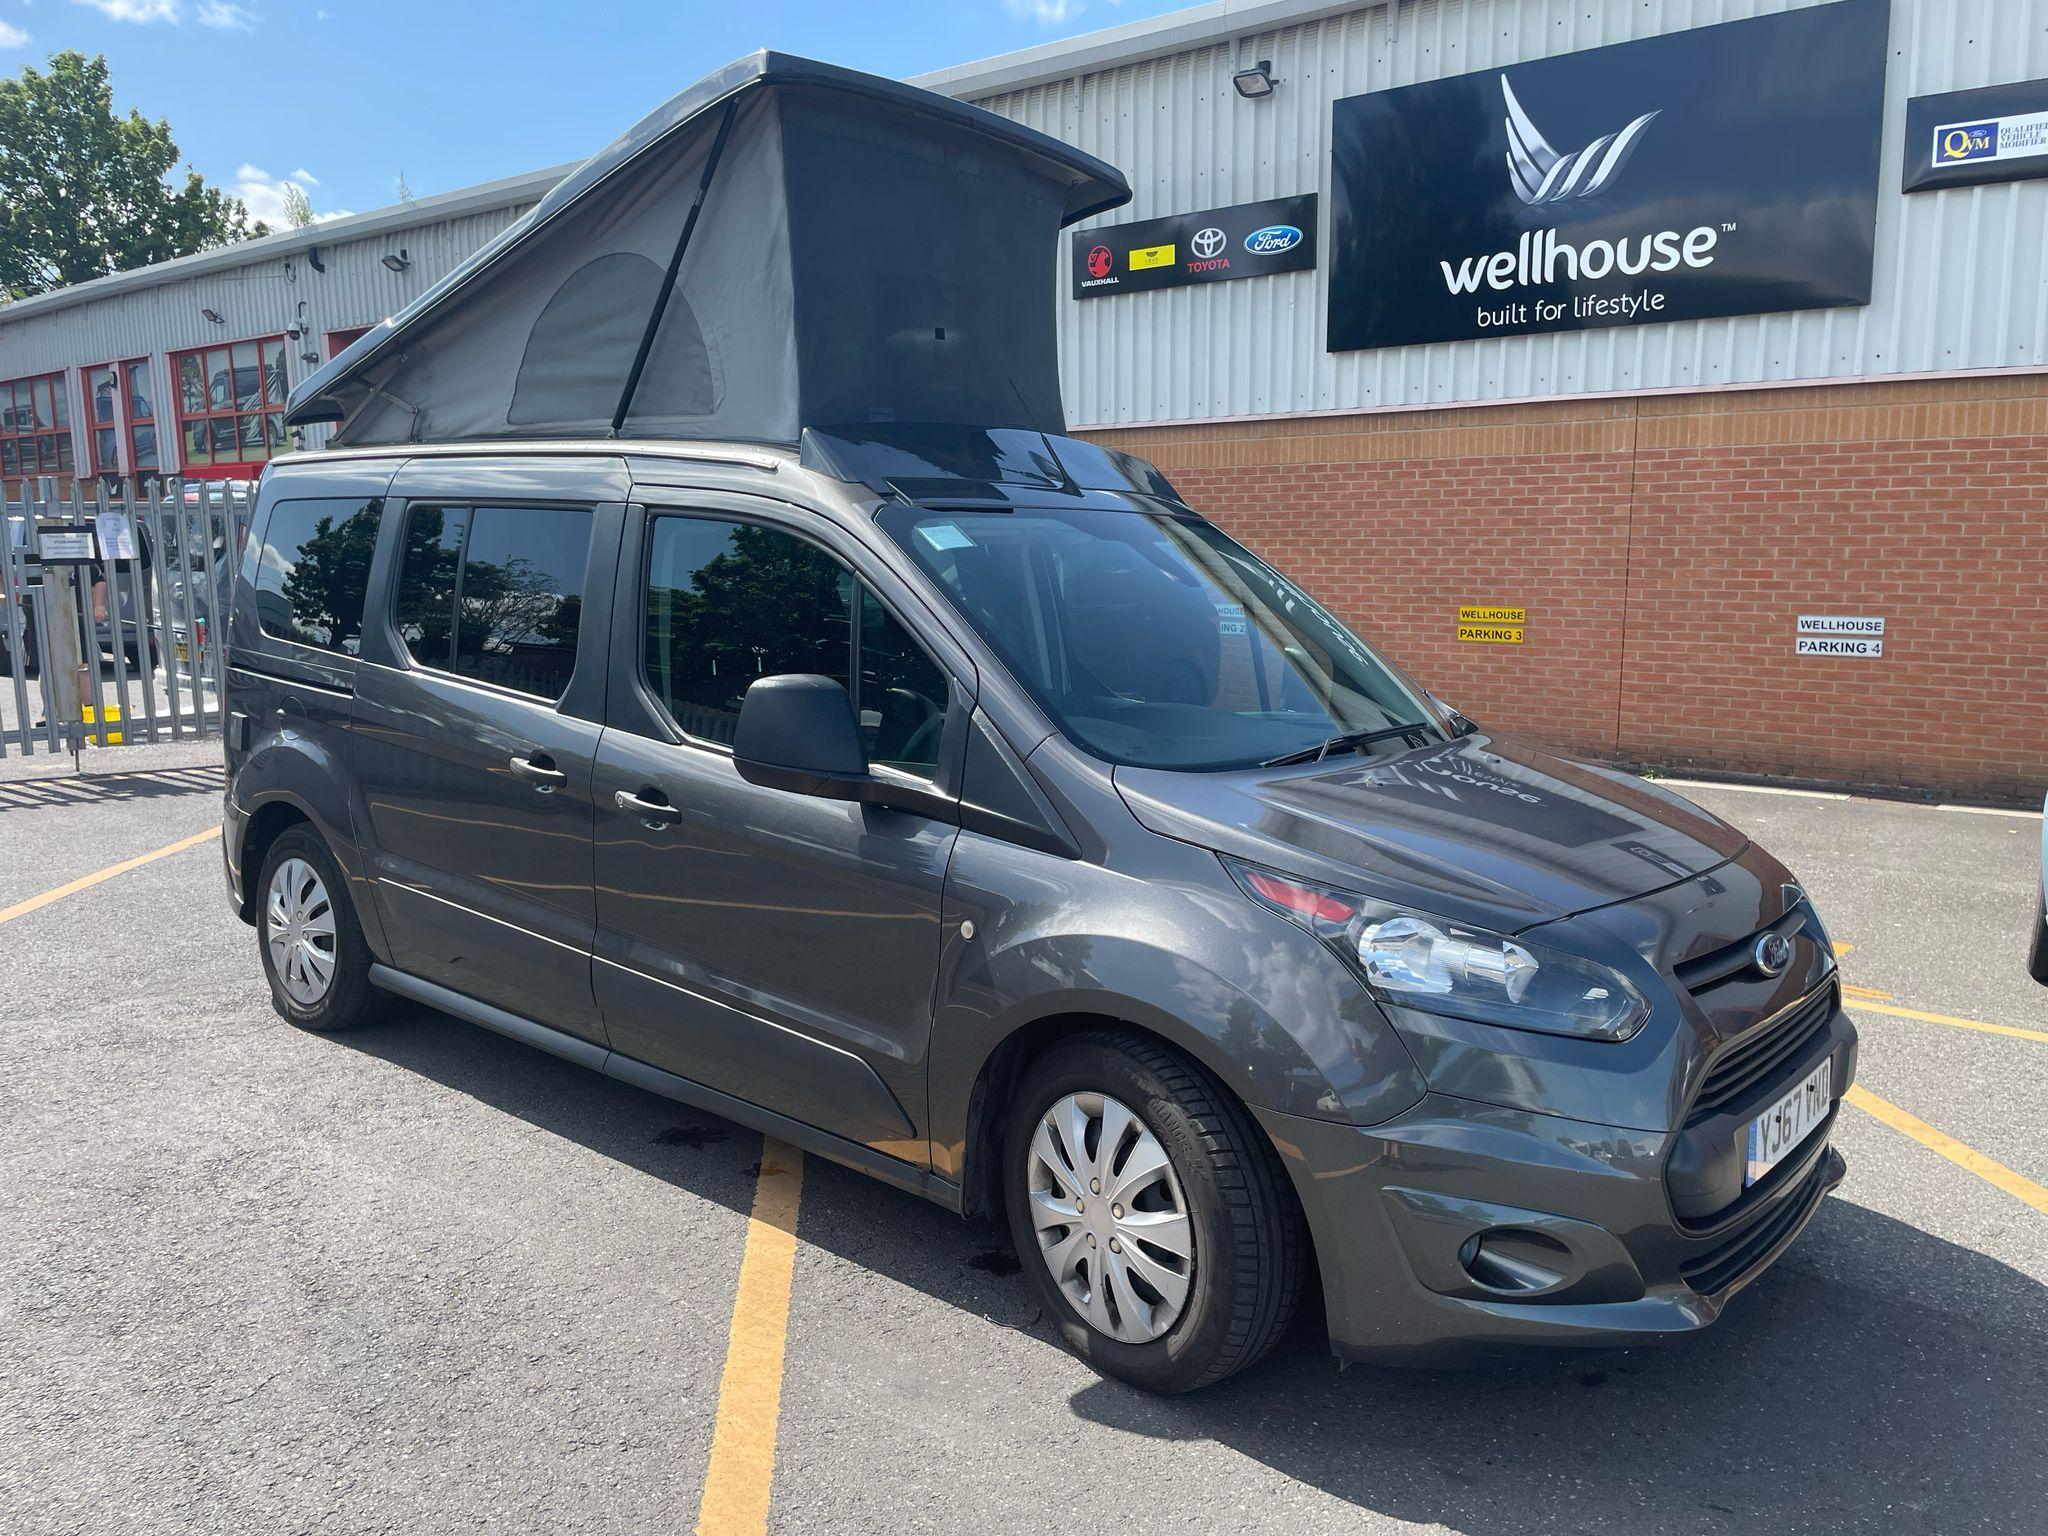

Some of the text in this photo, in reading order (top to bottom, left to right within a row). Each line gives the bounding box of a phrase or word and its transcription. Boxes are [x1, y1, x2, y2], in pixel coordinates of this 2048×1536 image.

[2000, 136, 2047, 149] MODIFIER
[2001, 131, 2042, 142] VEHICLE
[1254, 230, 1292, 251] Ford
[1187, 258, 1231, 273] TOYOTA
[1440, 226, 1718, 296] wellhouse
[1081, 276, 1120, 288] VAUXHALL
[1477, 289, 1666, 328] built for lifestyle
[1218, 607, 1245, 615] HOUSE
[1461, 610, 1524, 620] WELLHOUSE
[1800, 620, 1882, 631] WELLHOUSE
[1460, 629, 1522, 640] PARKING 3
[1799, 641, 1880, 654] PARKING 4
[1761, 1088, 1803, 1162] YJ67
